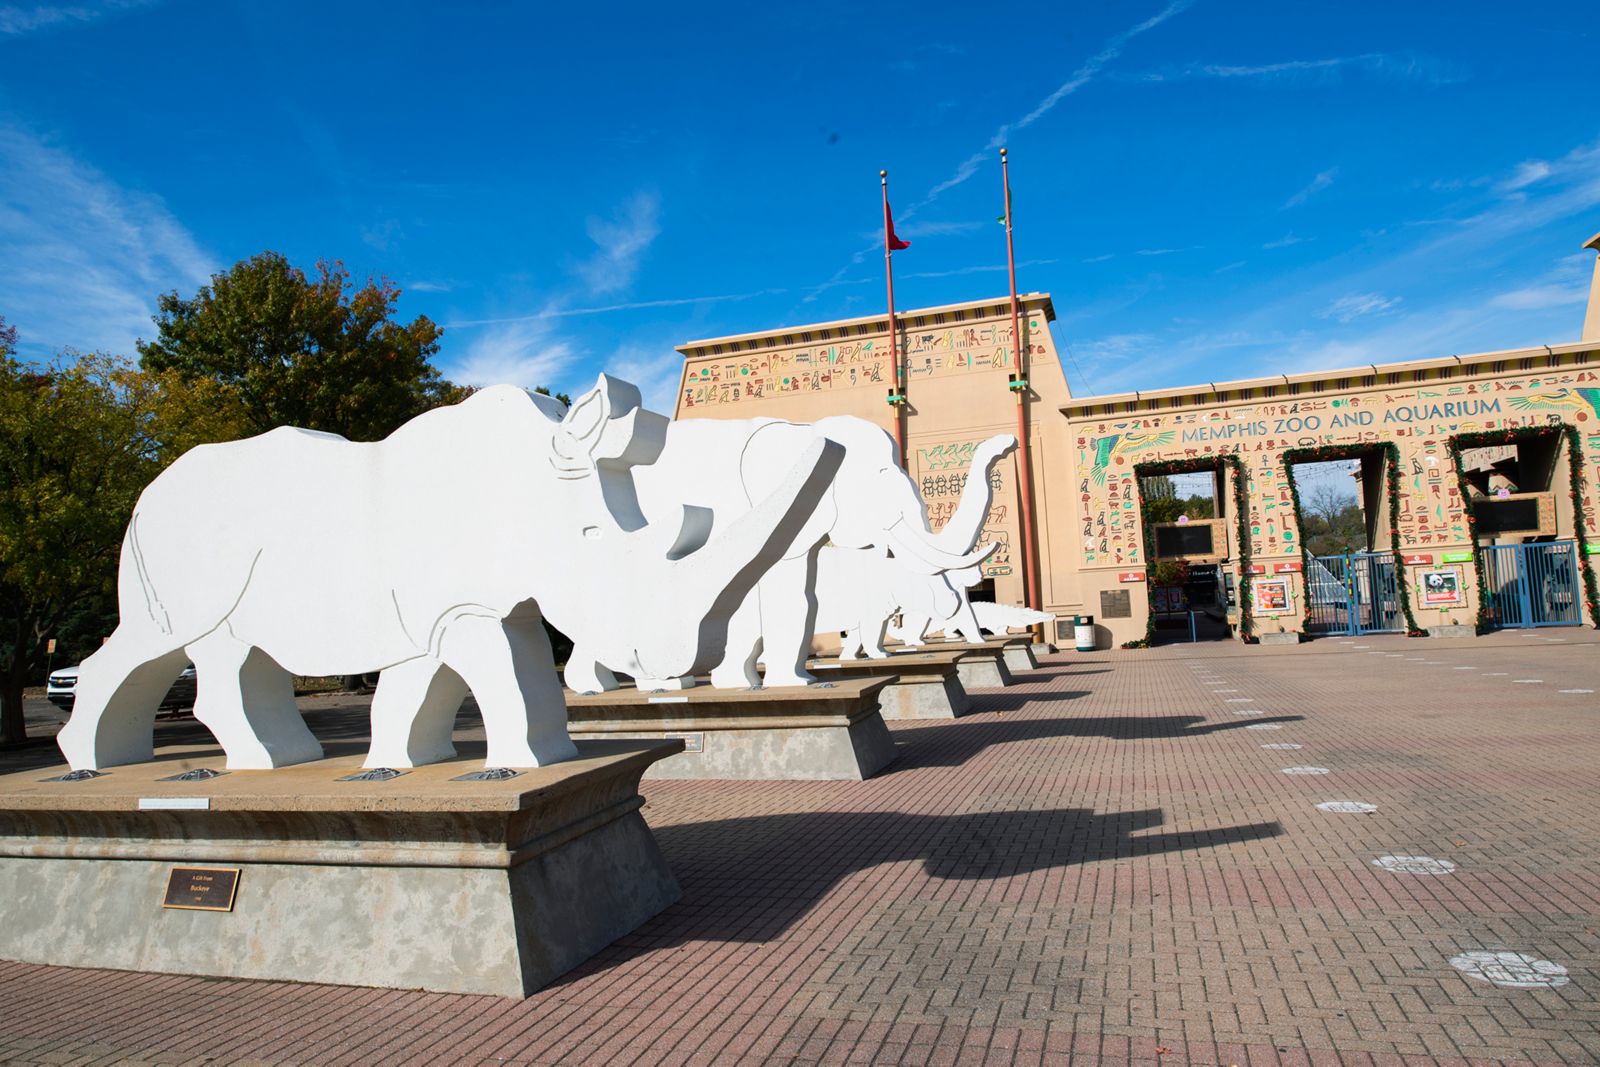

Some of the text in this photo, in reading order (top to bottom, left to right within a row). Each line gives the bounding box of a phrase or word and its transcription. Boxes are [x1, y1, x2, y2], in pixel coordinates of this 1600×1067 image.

[1182, 398, 1502, 443] MEMPHIS ZOO AND AQUARIUM
